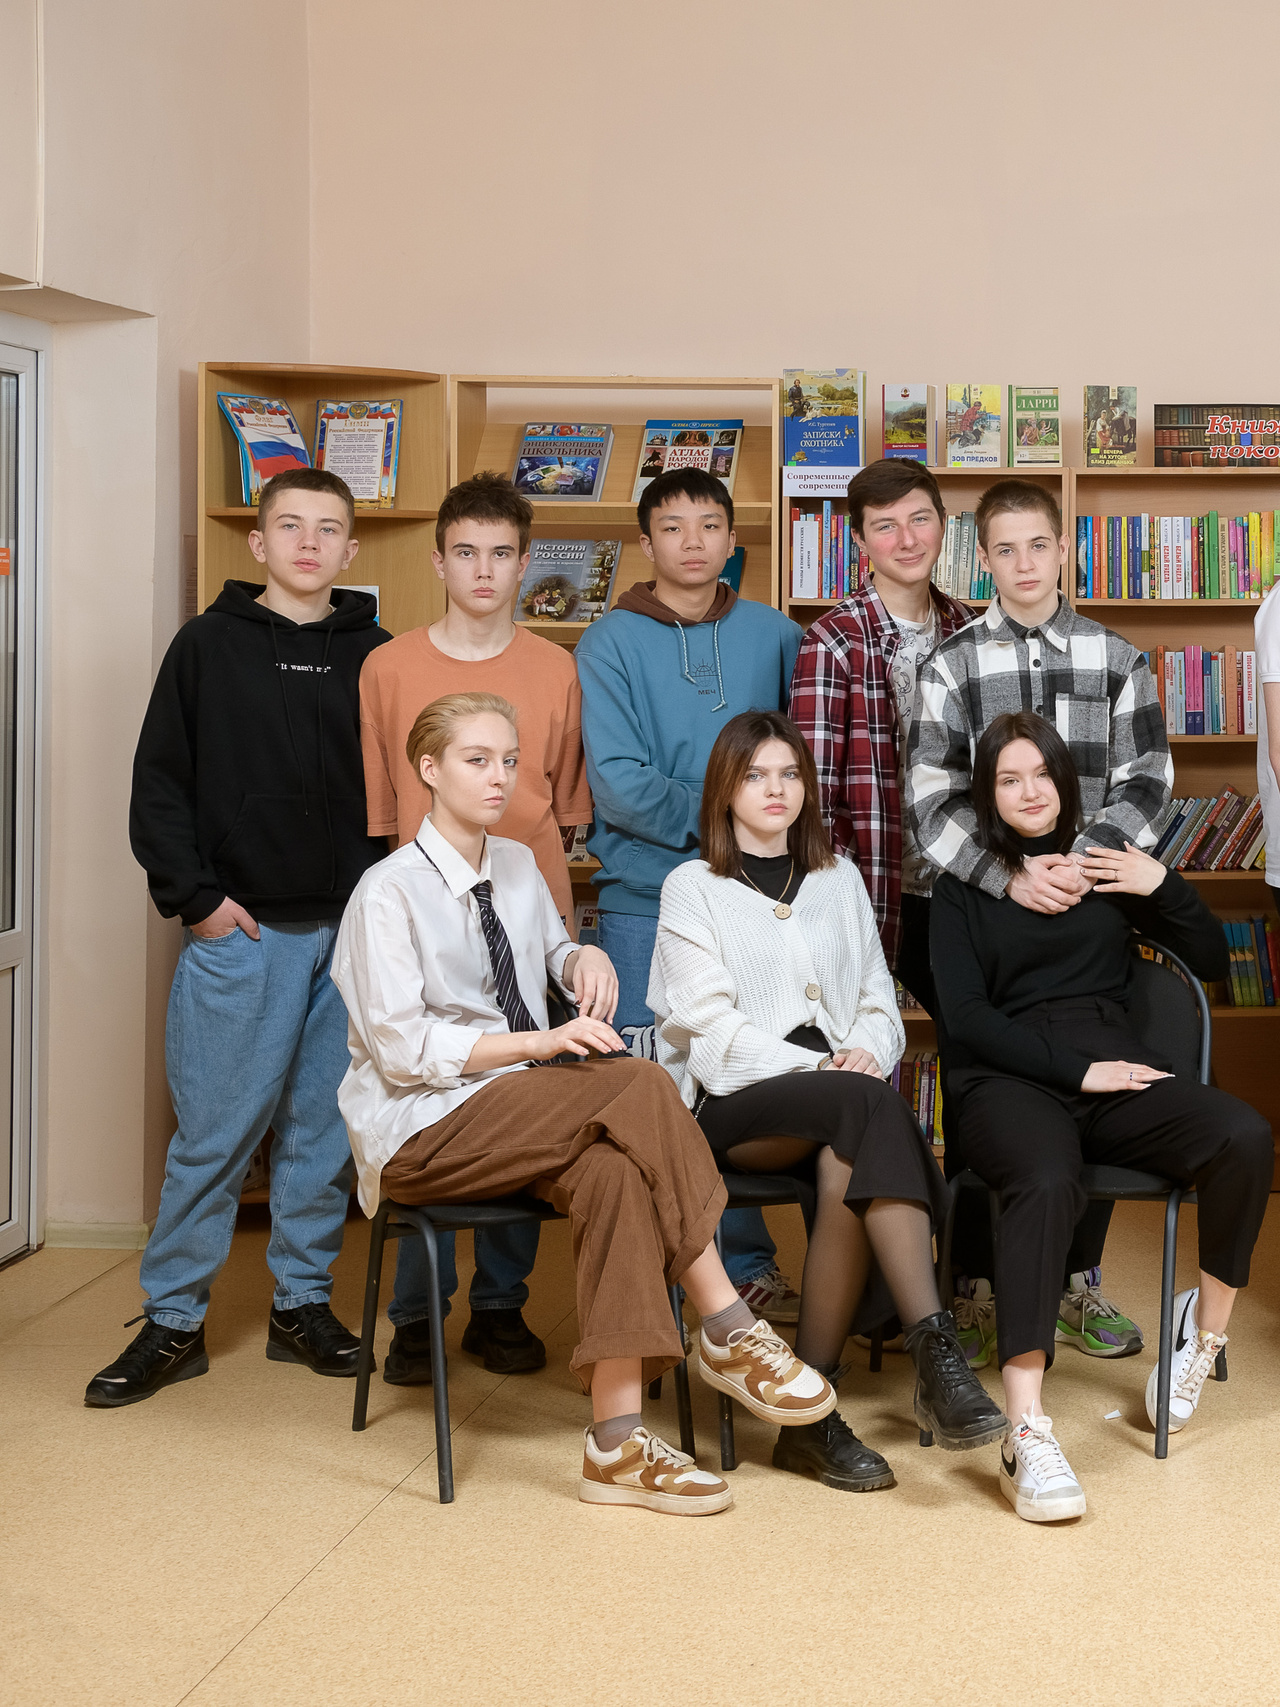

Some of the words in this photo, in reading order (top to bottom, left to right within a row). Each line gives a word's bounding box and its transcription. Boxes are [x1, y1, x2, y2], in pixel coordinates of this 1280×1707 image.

[1017, 399, 1057, 409] ЛАРРИ
[803, 431, 841, 439] ЗАПИСКИ
[800, 439, 844, 447] ОХОТНИКА
[522, 448, 603, 456] ШКОЛЬНИКА
[669, 449, 710, 457] АТЛАС
[952, 455, 966, 463] ЗОВ
[966, 455, 998, 463] ПРЕДКОВ
[787, 472, 850, 482] Современные
[536, 543, 587, 552] ИСТОРИЯ
[534, 551, 585, 560] РОССИИ
